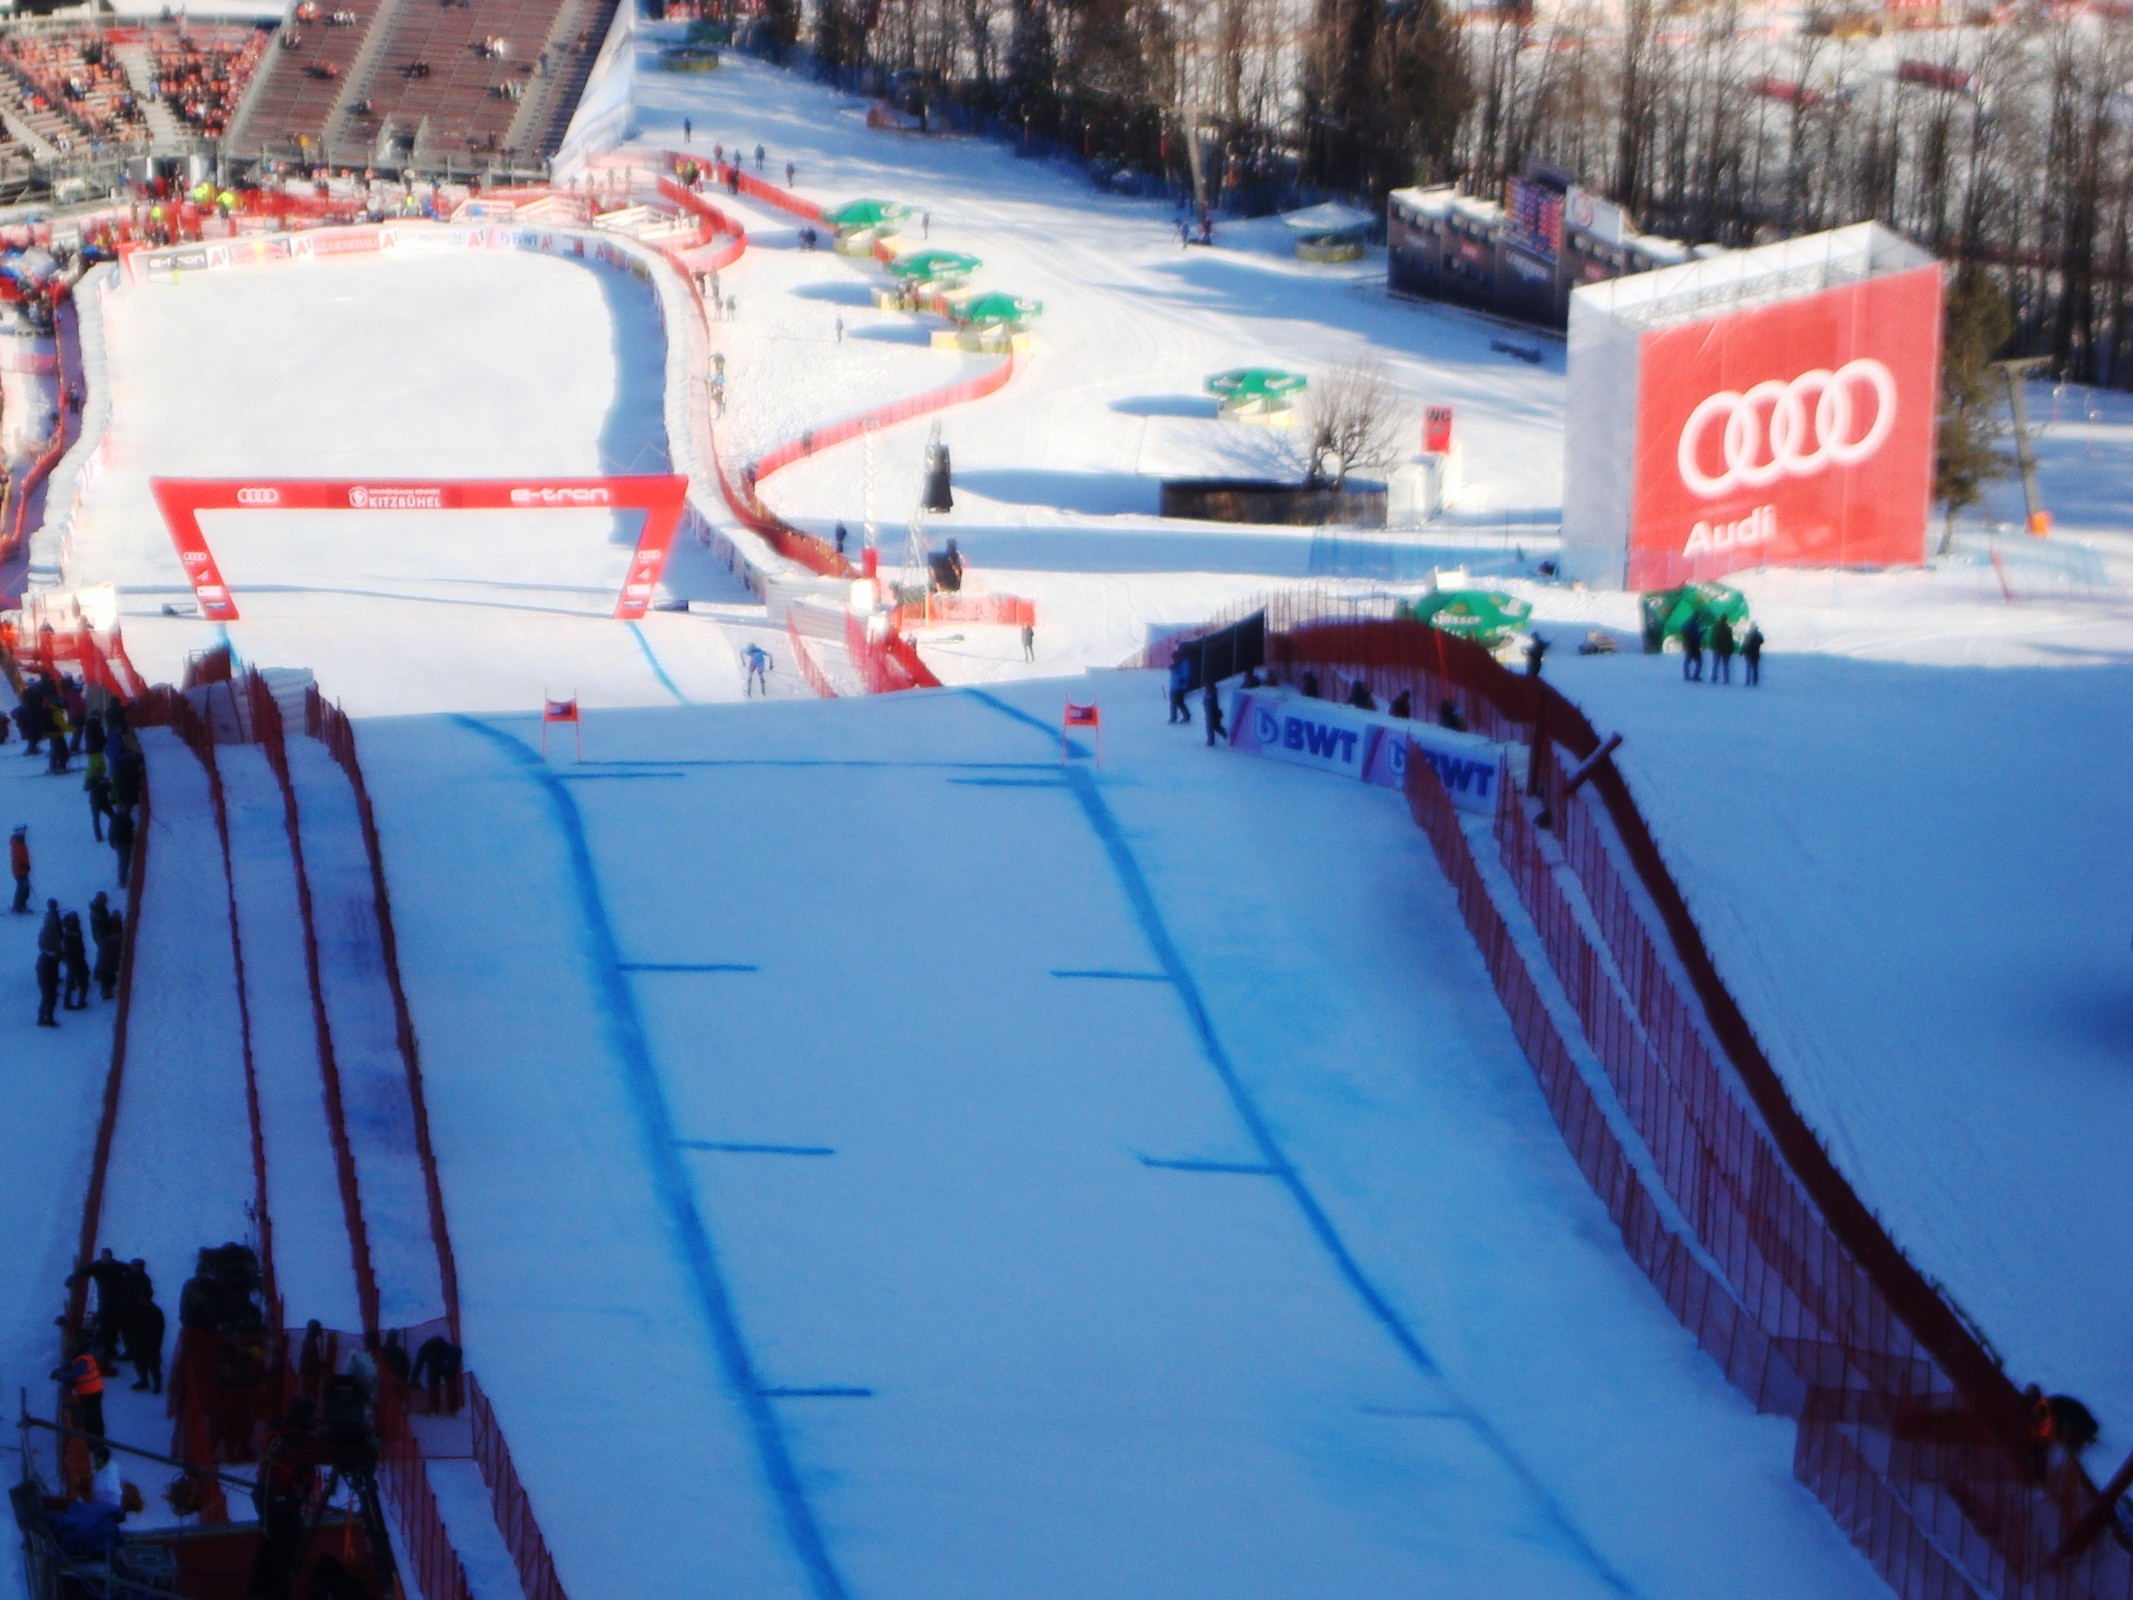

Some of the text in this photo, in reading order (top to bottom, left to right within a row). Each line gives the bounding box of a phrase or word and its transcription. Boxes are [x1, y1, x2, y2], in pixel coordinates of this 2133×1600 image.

[369, 494, 442, 508] KITZBÜHEL
[511, 488, 609, 503] e-tron
[1682, 503, 1777, 558] Audi
[1283, 716, 1358, 764] BWT
